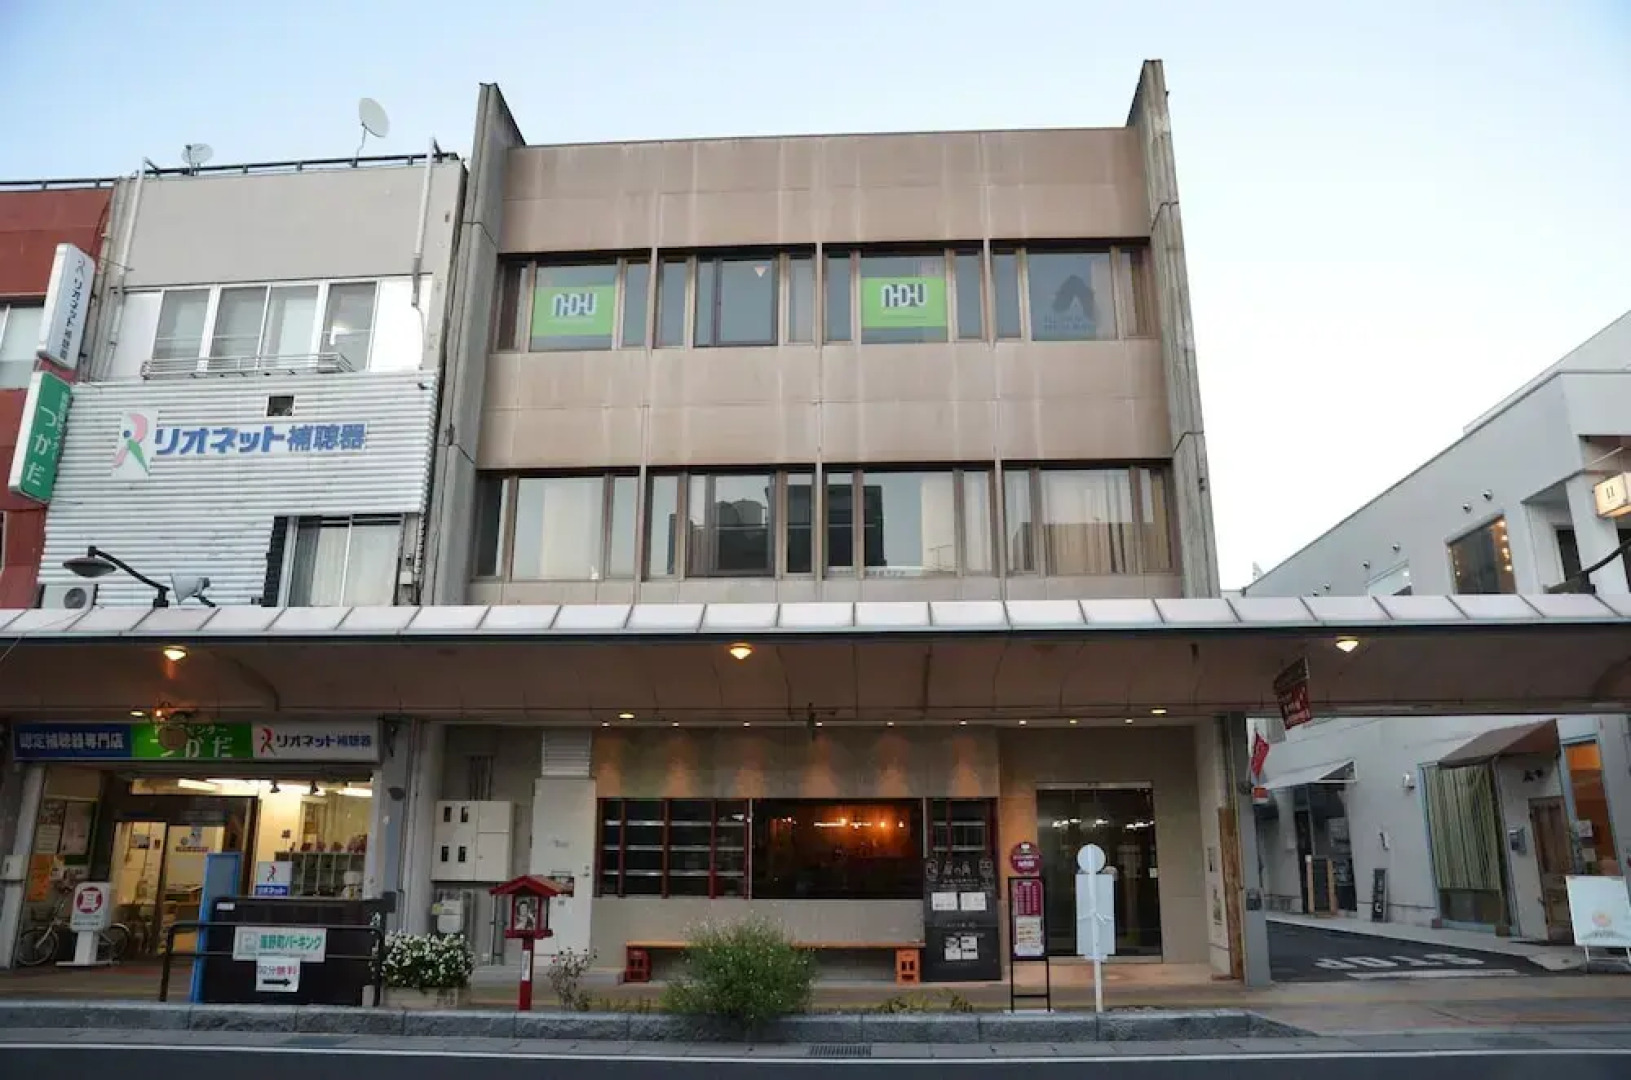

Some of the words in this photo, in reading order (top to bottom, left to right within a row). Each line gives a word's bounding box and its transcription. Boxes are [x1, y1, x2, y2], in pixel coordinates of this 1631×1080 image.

[154, 423, 366, 456] リオネット補聴器
[276, 734, 371, 748] リオネット補聴器
